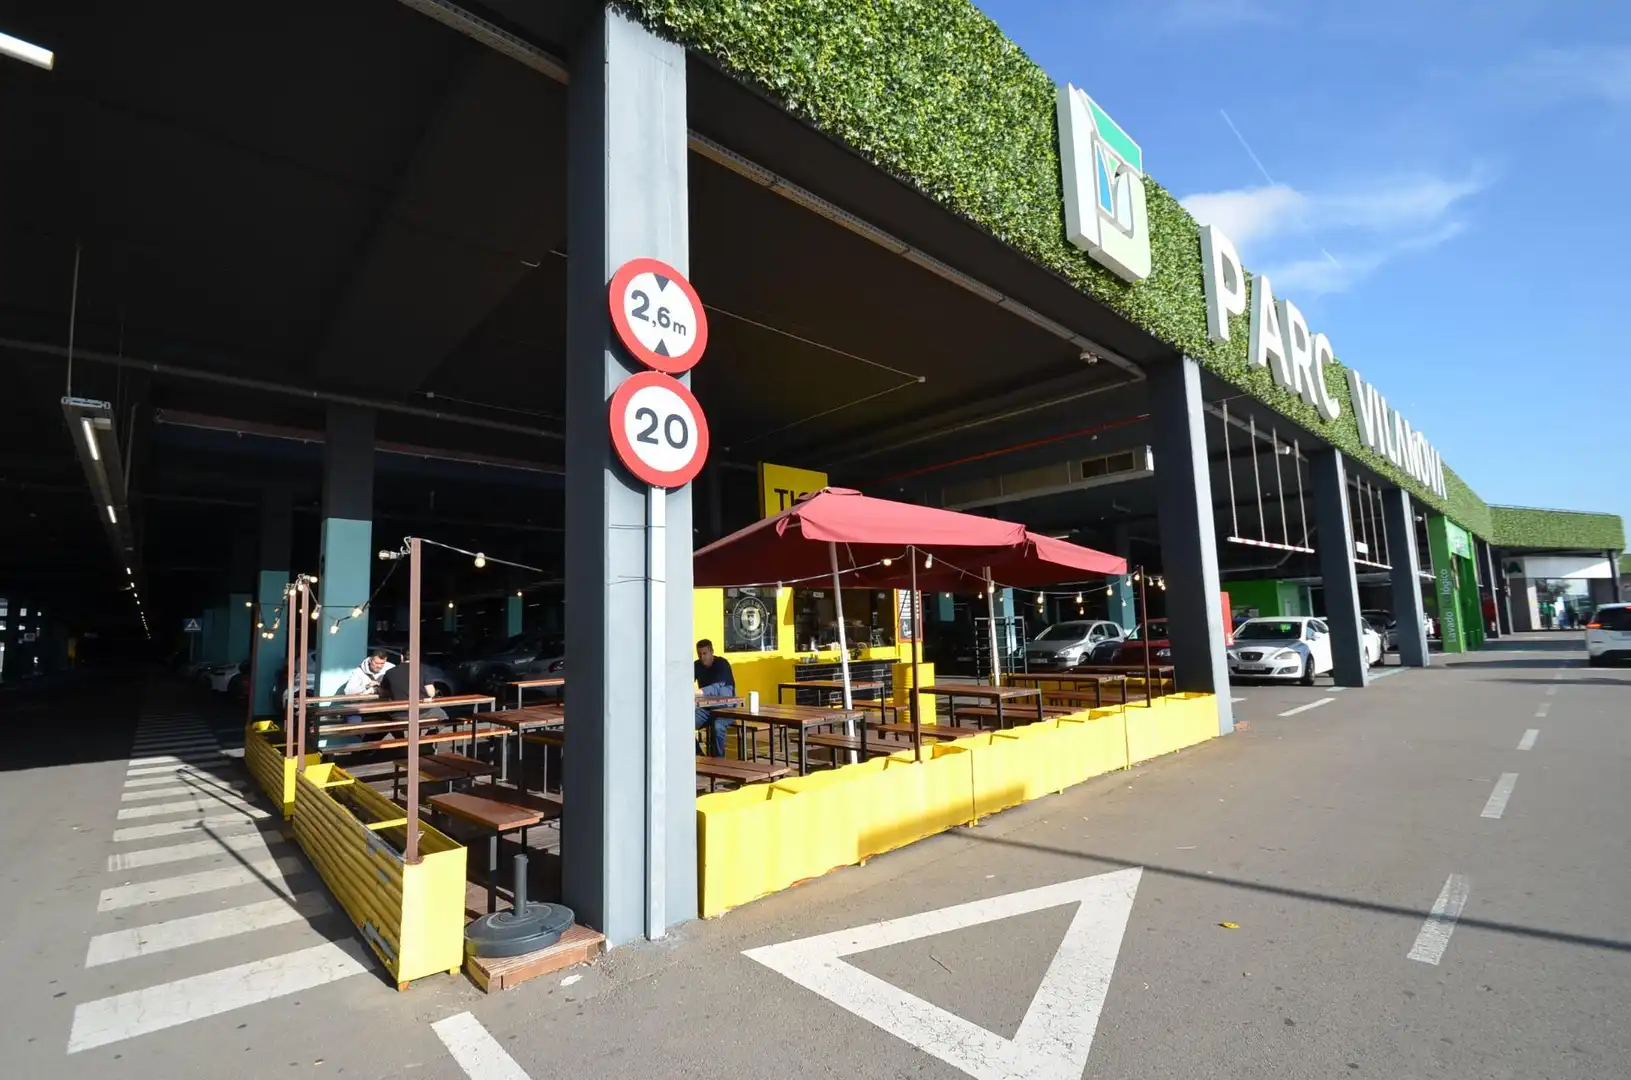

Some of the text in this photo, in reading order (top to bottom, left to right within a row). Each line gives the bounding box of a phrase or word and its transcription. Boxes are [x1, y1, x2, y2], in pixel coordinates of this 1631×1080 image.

[1201, 224, 1448, 501] PARC VILANOVA
[635, 407, 689, 450] 20
[1443, 611, 1457, 643] Lavado
